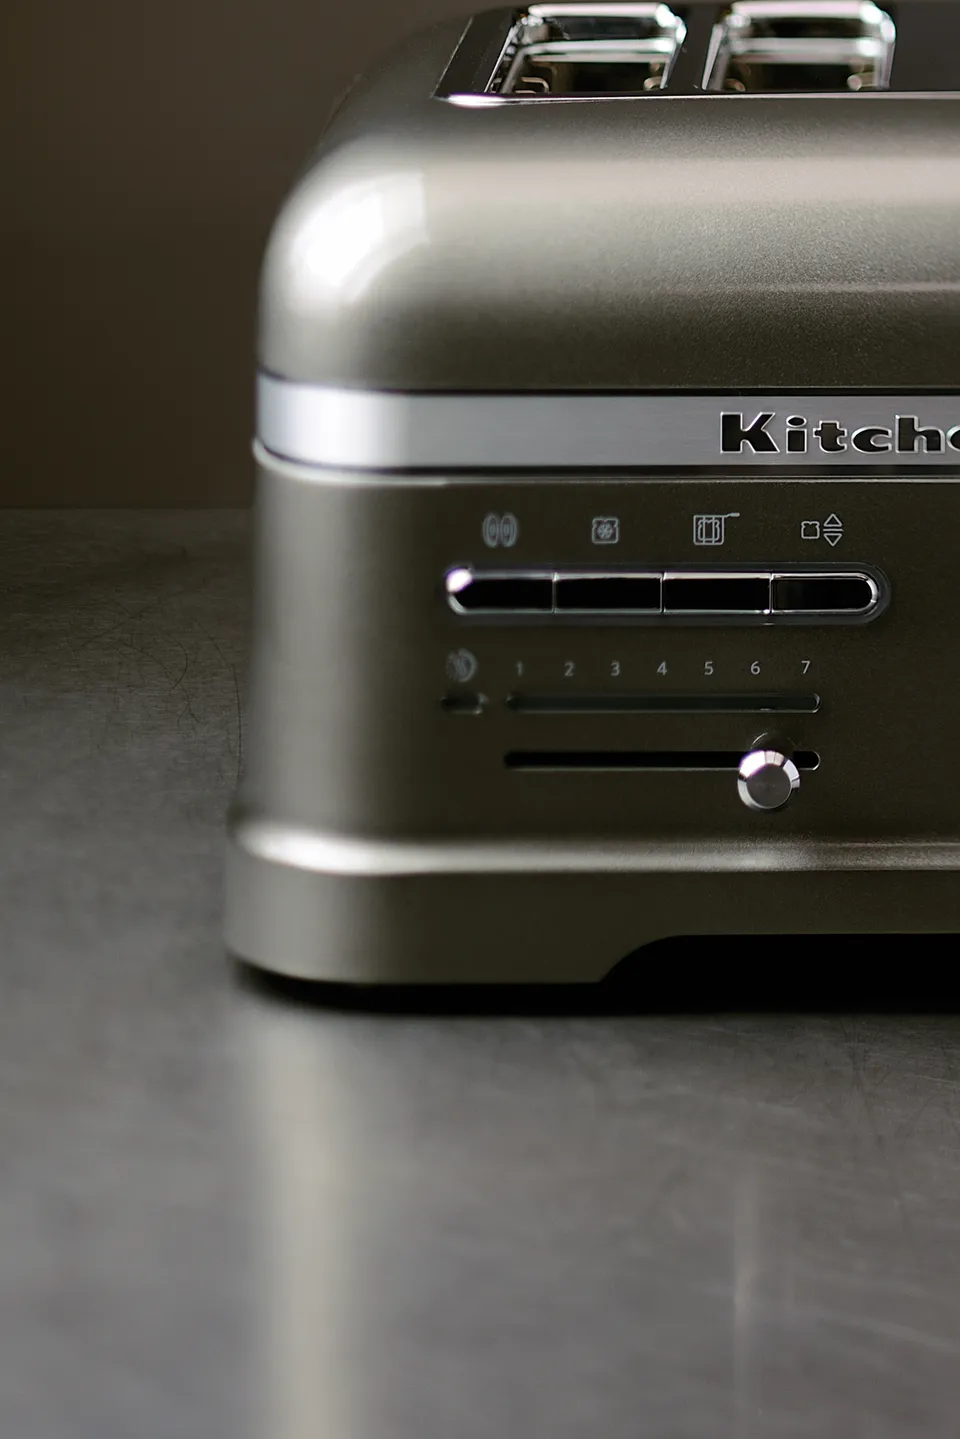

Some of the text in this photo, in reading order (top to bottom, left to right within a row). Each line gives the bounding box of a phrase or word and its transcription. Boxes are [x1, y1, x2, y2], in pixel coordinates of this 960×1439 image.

[516, 659, 811, 677] 1 2 3 4 5 6 7
